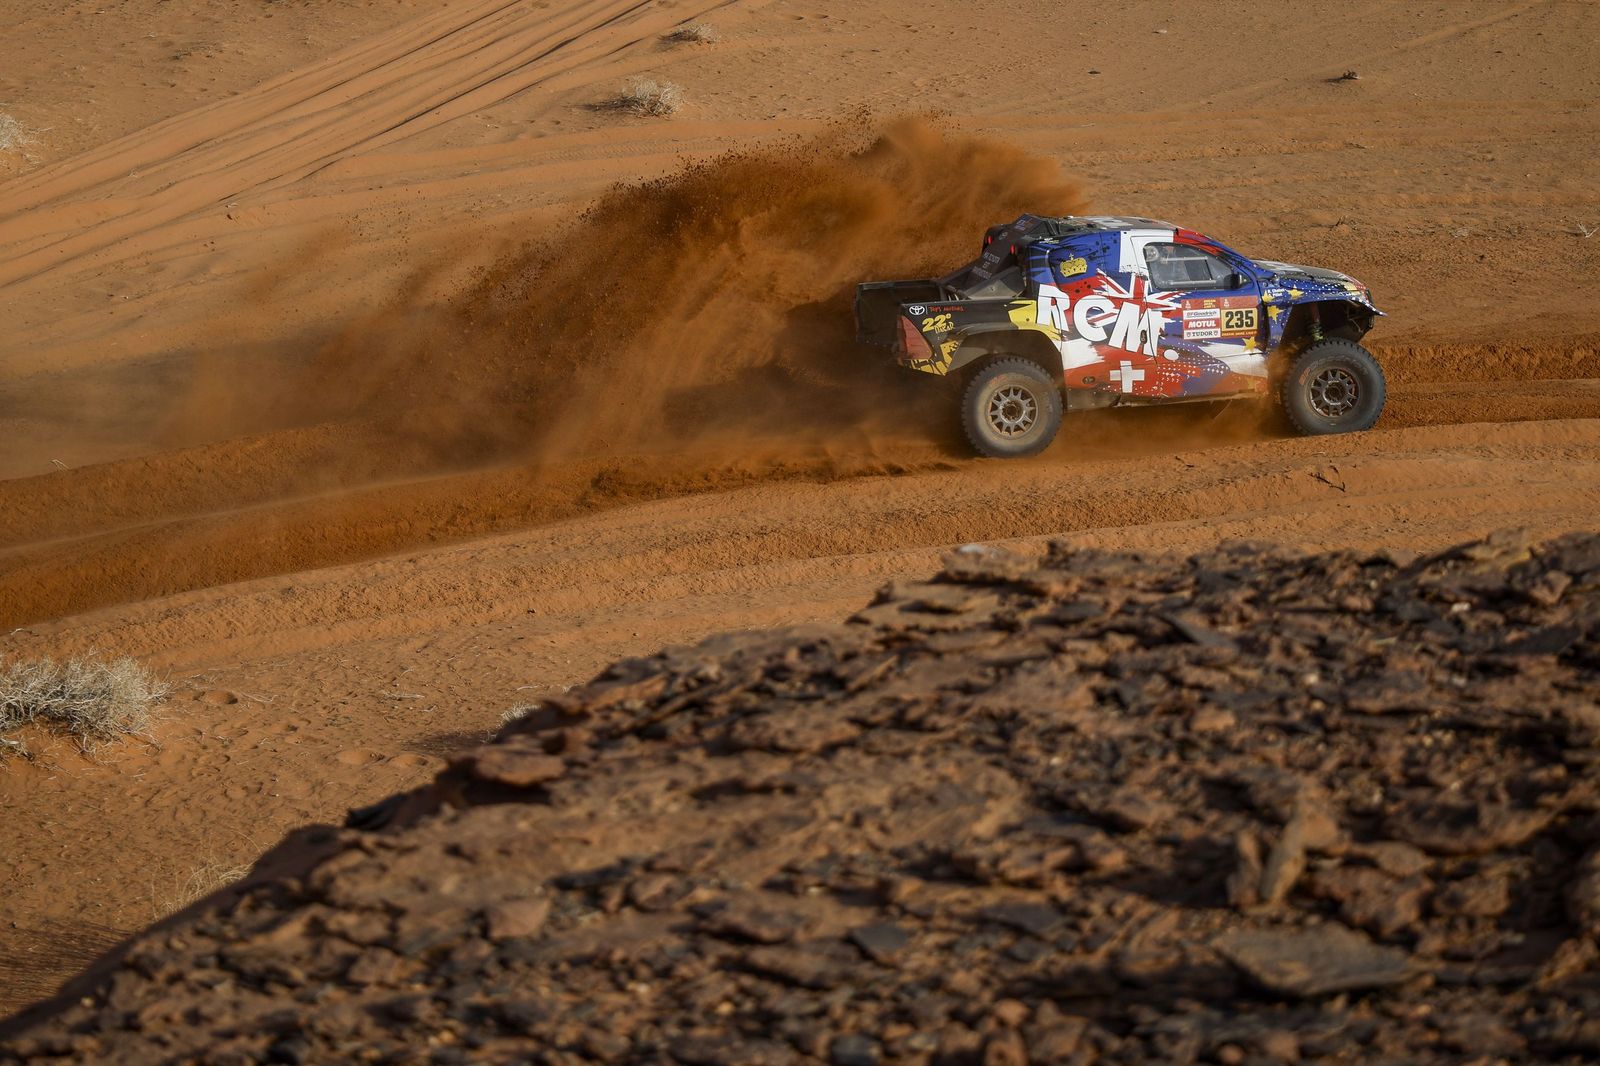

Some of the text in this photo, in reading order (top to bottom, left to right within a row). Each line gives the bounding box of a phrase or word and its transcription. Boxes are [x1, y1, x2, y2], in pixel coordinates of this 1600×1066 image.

[1225, 310, 1254, 329] 235
[1188, 320, 1216, 329] MOTUL
[1192, 330, 1213, 338] TUDOR
